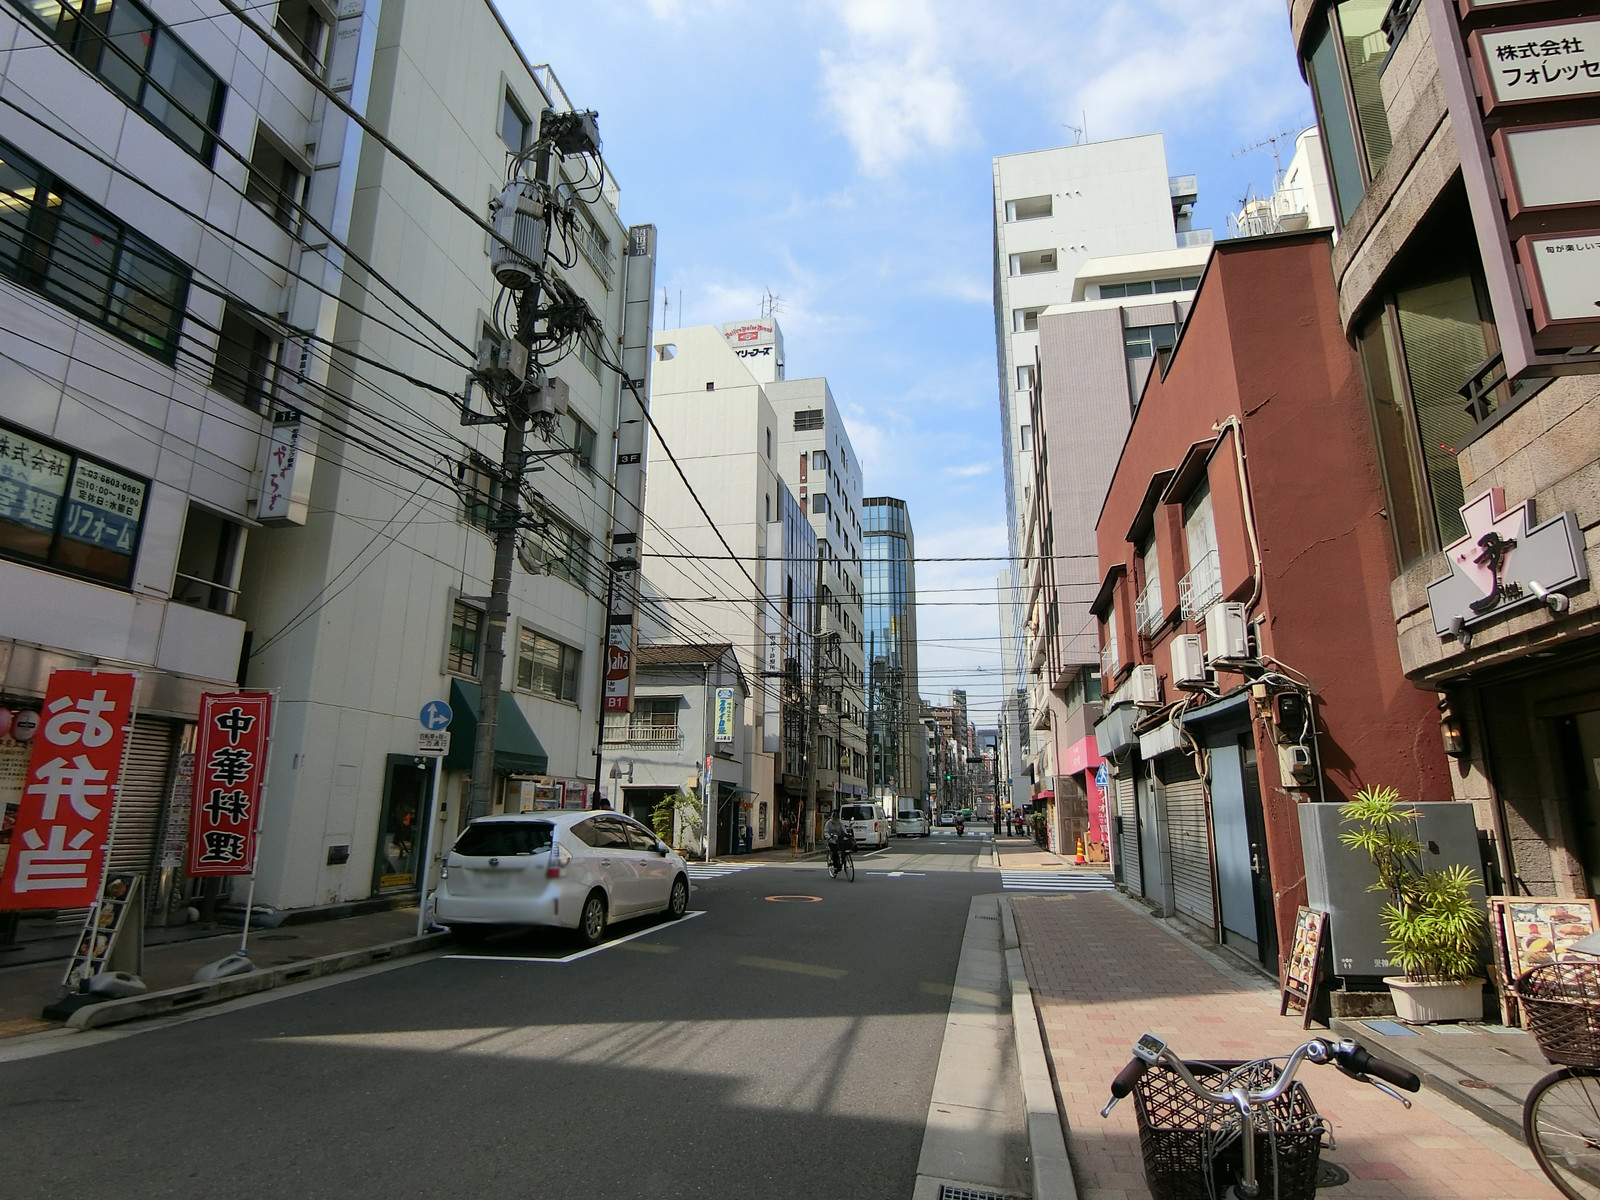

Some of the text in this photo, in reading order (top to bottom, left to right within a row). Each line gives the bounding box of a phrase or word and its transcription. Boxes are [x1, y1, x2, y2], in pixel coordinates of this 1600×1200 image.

[1496, 37, 1584, 61] 株式会社
[0, 435, 65, 477] 株式会社
[621, 455, 638, 464] 3F
[68, 503, 131, 550] リフォーム
[608, 698, 622, 707] B1
